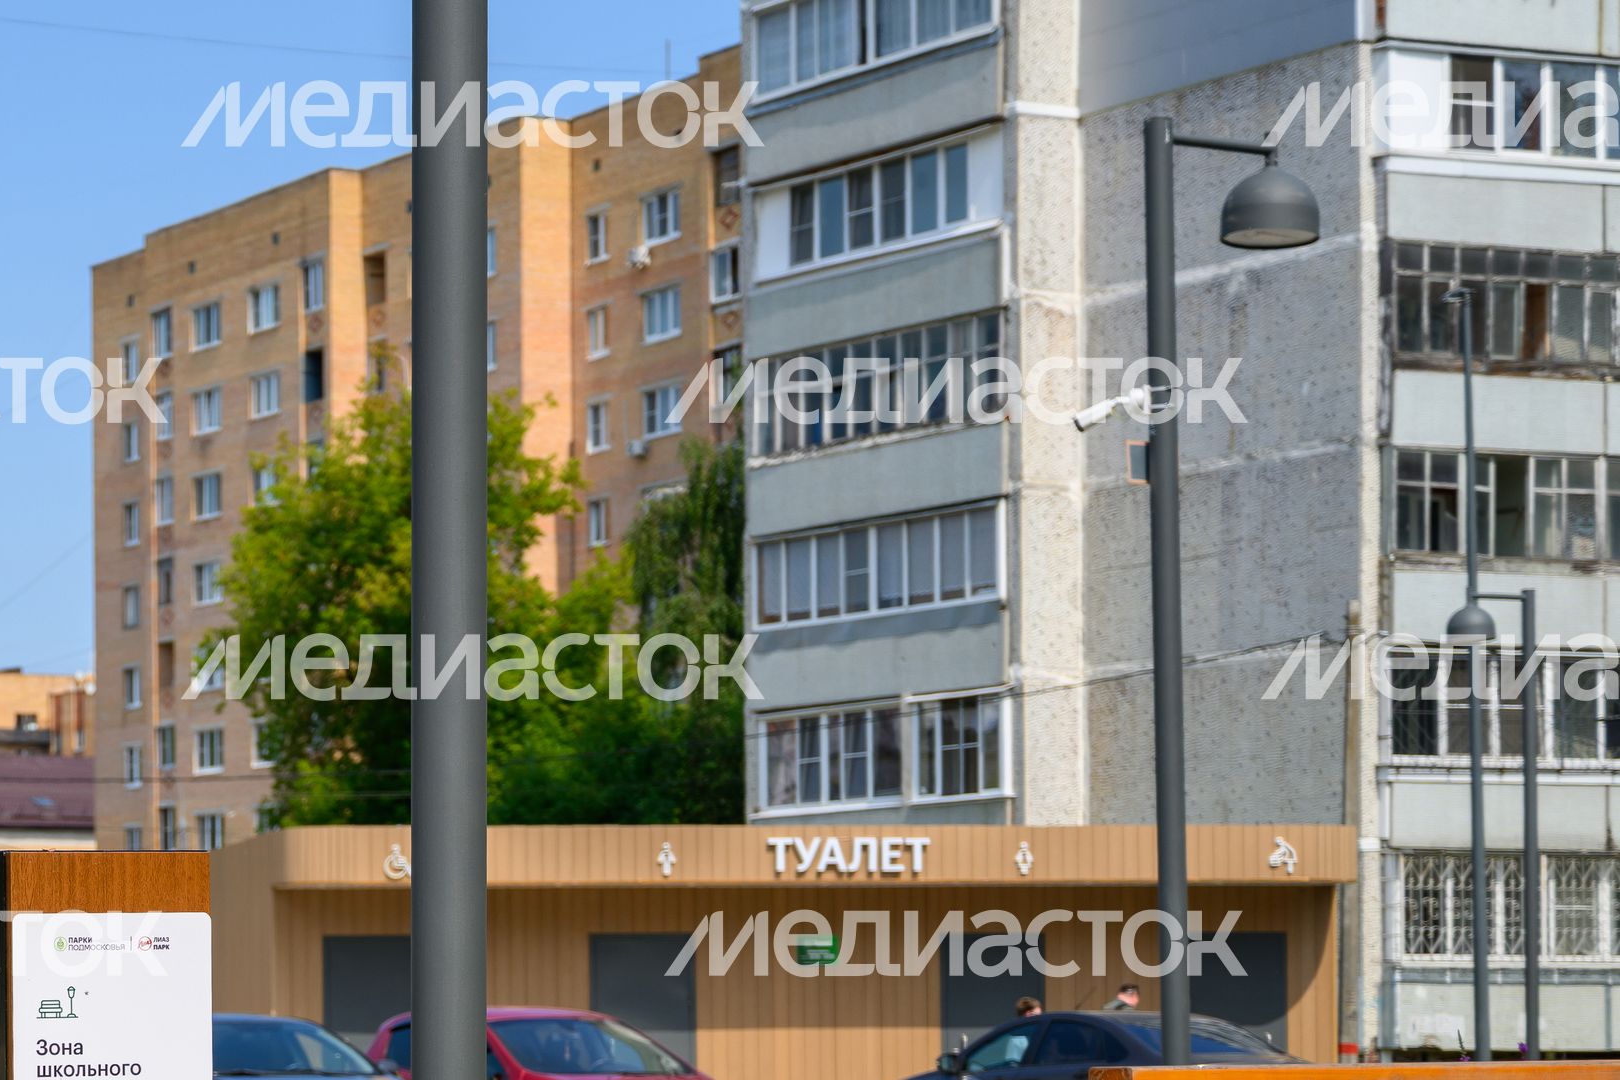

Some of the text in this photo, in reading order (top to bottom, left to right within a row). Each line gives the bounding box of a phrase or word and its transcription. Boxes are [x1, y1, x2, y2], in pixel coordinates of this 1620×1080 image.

[767, 836, 931, 873] ТУАЛЕТ
[68, 936, 92, 944] ПАРКИ
[36, 1039, 83, 1056] Зона
[37, 1063, 142, 1078] школьного
